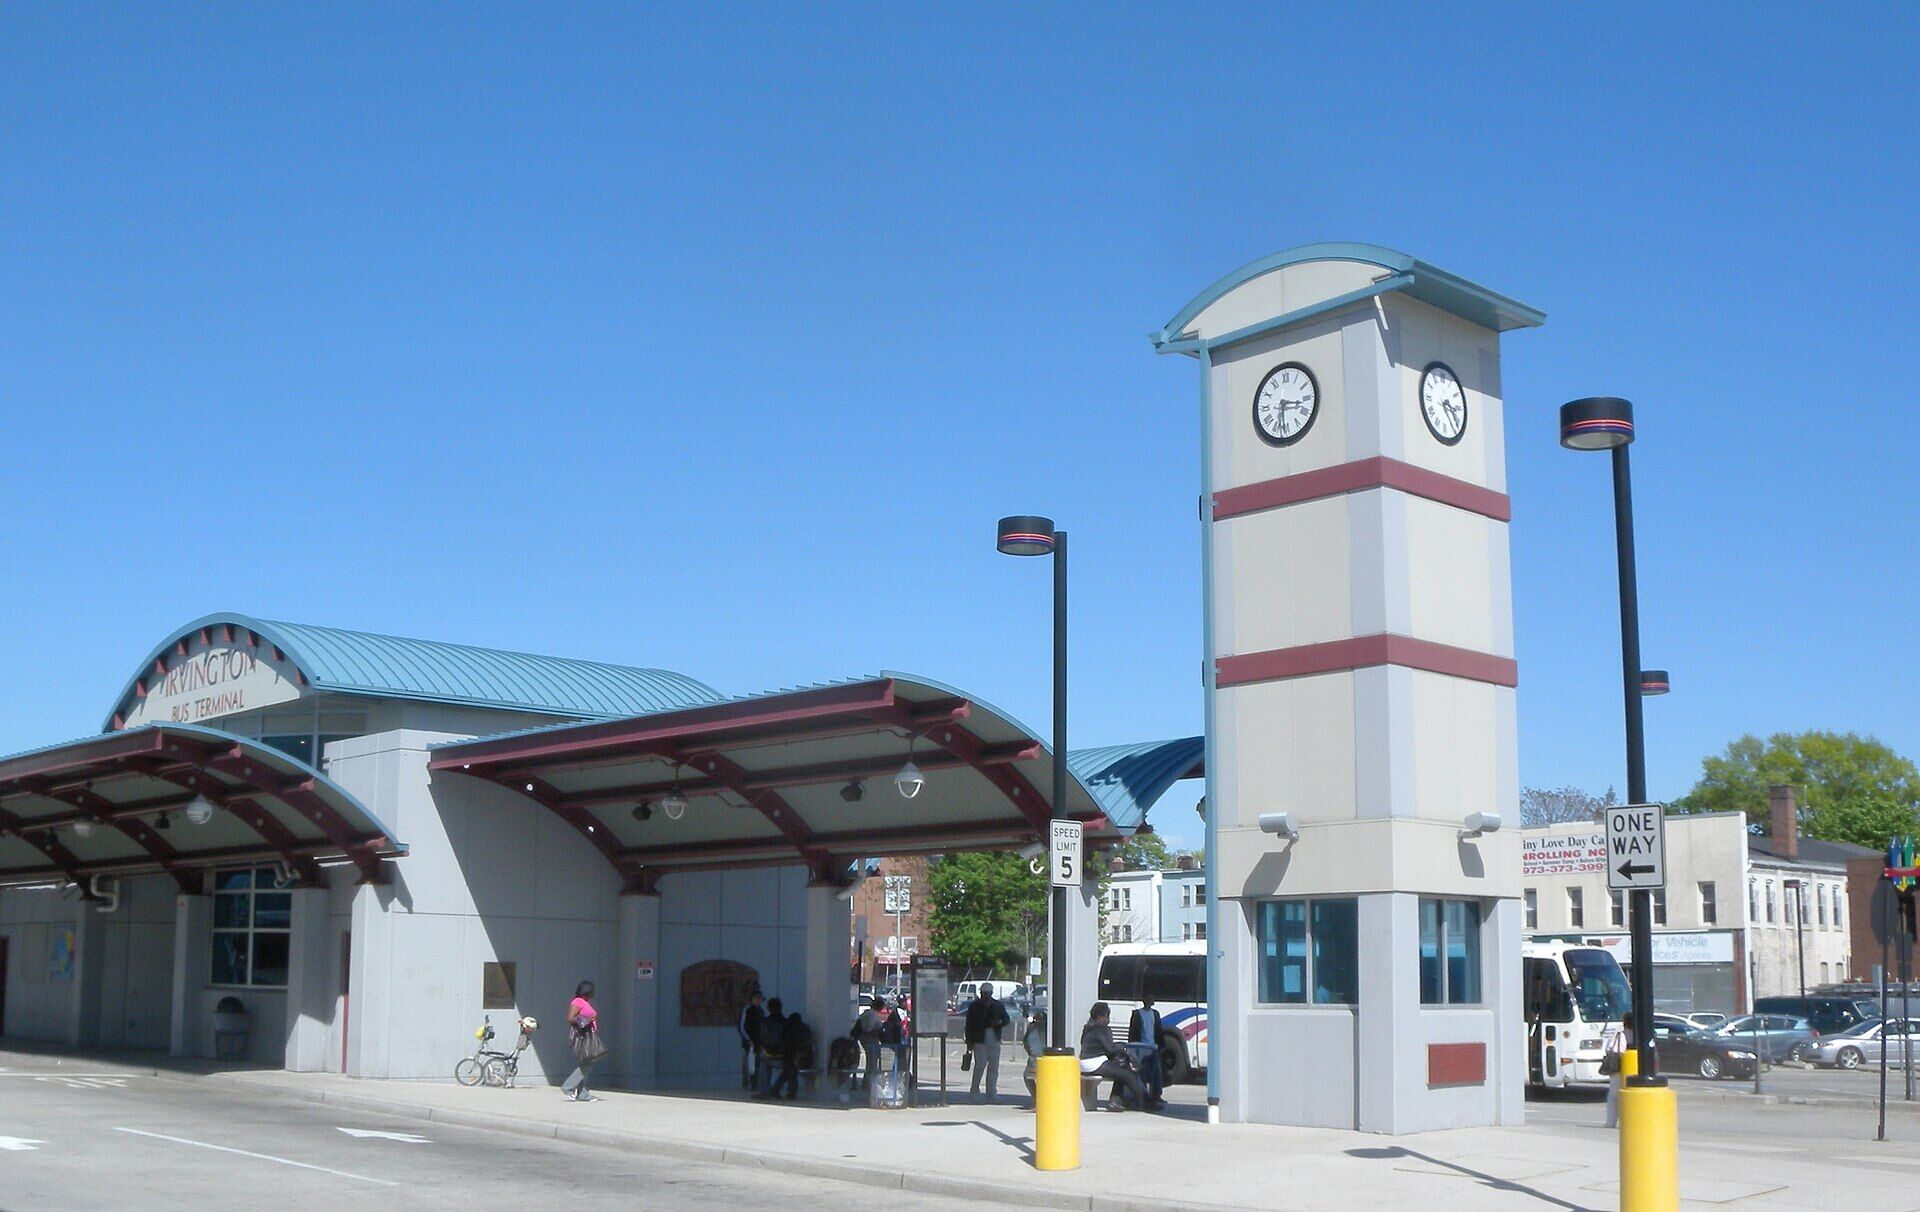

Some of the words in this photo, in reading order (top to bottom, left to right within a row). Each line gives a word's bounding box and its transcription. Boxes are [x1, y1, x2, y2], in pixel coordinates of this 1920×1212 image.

[165, 648, 257, 697] IRVINGTON
[172, 702, 190, 722] BUS
[195, 688, 245, 719] TERMINAL
[1613, 812, 1655, 833] ONE
[1053, 827, 1080, 839] SPEED
[1056, 841, 1077, 852] LIMIT
[1523, 839, 1538, 852] iny
[1541, 838, 1565, 849] Love
[1568, 836, 1587, 849] Day
[1591, 835, 1606, 846] Ca
[1612, 835, 1656, 855] WAY
[1523, 849, 1582, 860] NROLLING
[1588, 848, 1607, 857] NO
[1061, 855, 1073, 879] 5
[1666, 936, 1708, 947] Vehicle
